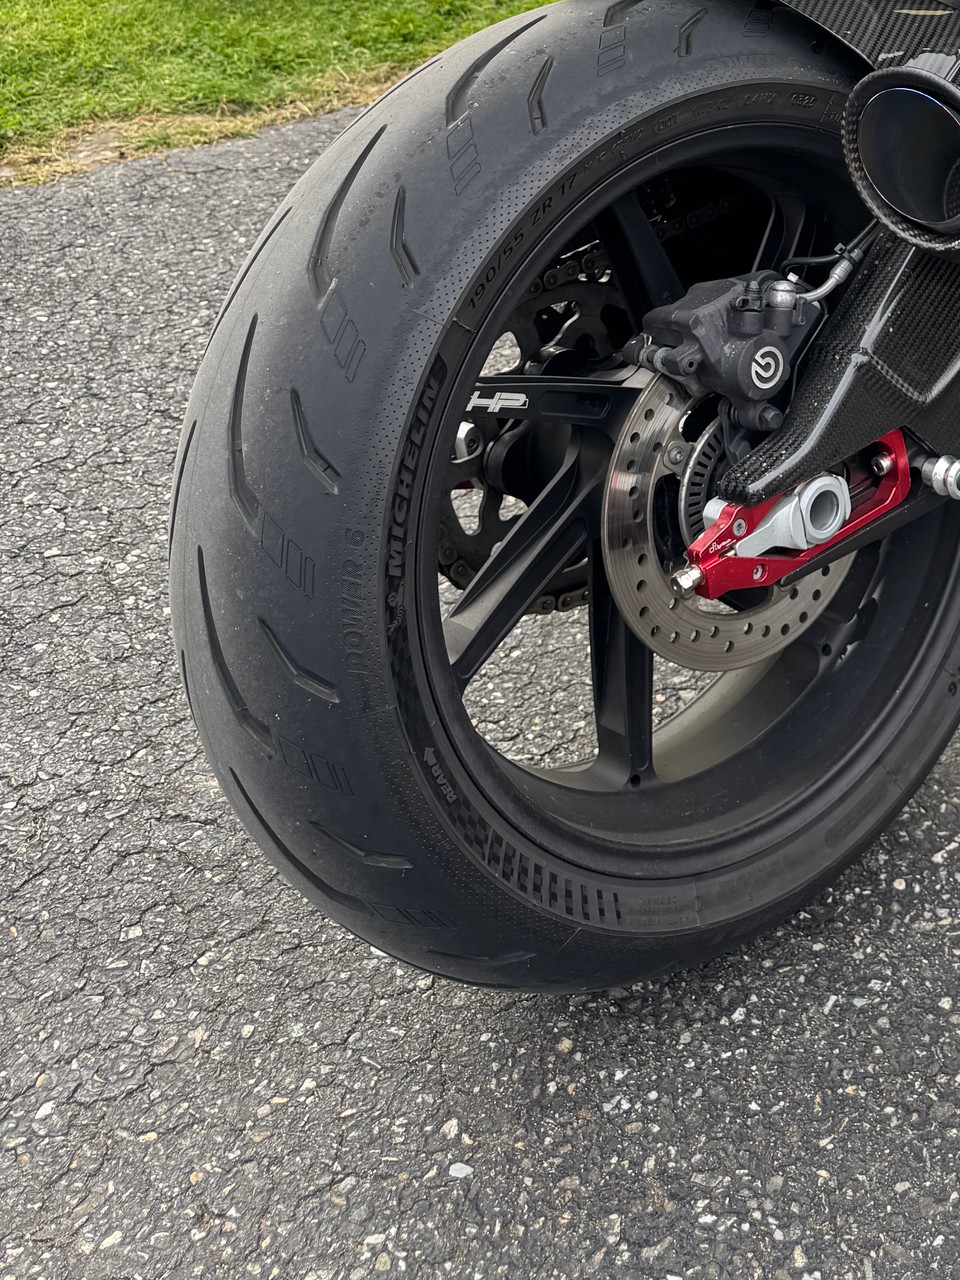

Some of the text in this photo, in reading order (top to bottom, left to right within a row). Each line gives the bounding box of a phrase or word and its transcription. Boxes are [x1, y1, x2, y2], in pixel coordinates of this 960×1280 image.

[468, 227, 525, 310] 190/55
[530, 197, 553, 228] ZR
[558, 172, 578, 197] 17
[465, 391, 529, 412] HP
[388, 375, 440, 577] MICHELIN
[342, 527, 366, 674] POWER 6
[948, 681, 958, 697] 6
[431, 763, 457, 804] REAR
